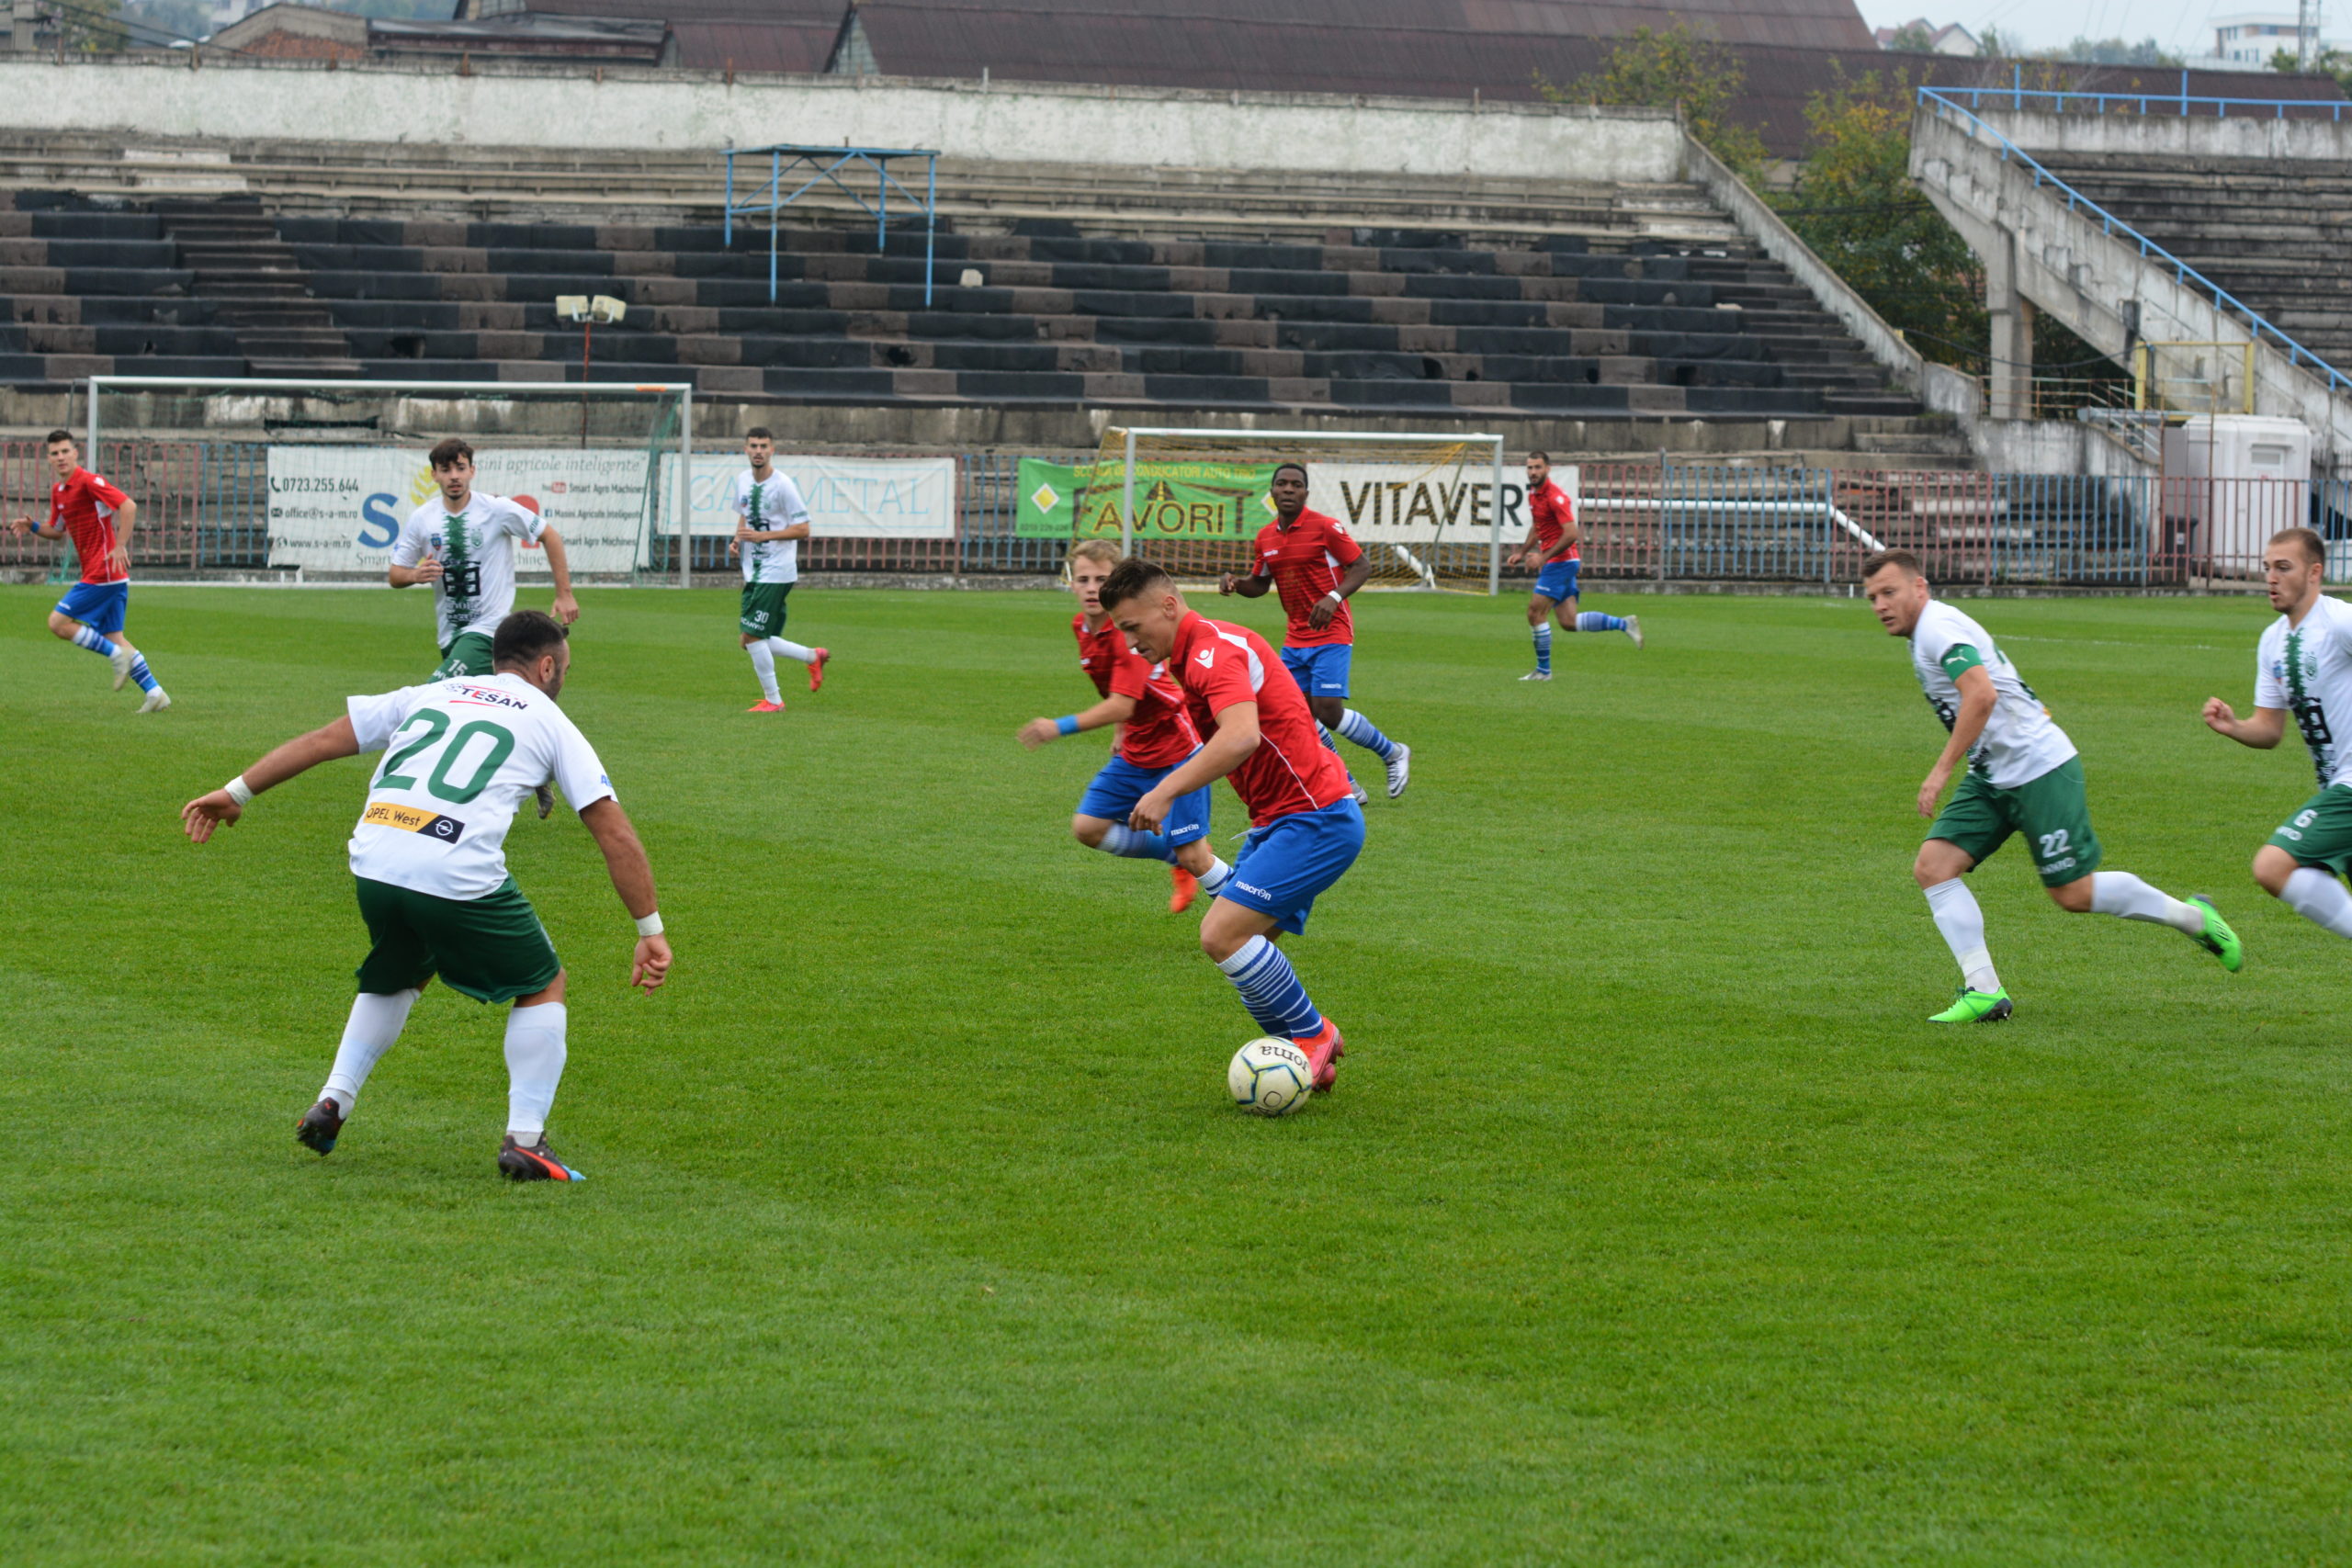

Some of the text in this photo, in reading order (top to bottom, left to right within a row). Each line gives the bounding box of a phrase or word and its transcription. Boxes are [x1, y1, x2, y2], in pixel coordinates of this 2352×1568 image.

[1128, 464, 1201, 478] ONDUCATORI
[283, 477, 358, 492] 0723.255.644
[1072, 480, 1255, 535] FAVORIT
[1340, 480, 1531, 527] VITAVER
[285, 507, 357, 520] office@s-a-m.ro
[289, 538, 352, 549] www.s-a-m.ro
[754, 609, 770, 624] 30
[447, 659, 468, 676] 15
[373, 707, 515, 805] 20
[367, 807, 421, 827] OPEL West
[2293, 809, 2318, 828] 6
[2039, 829, 2073, 858] 22
[1235, 880, 1272, 901] macron
